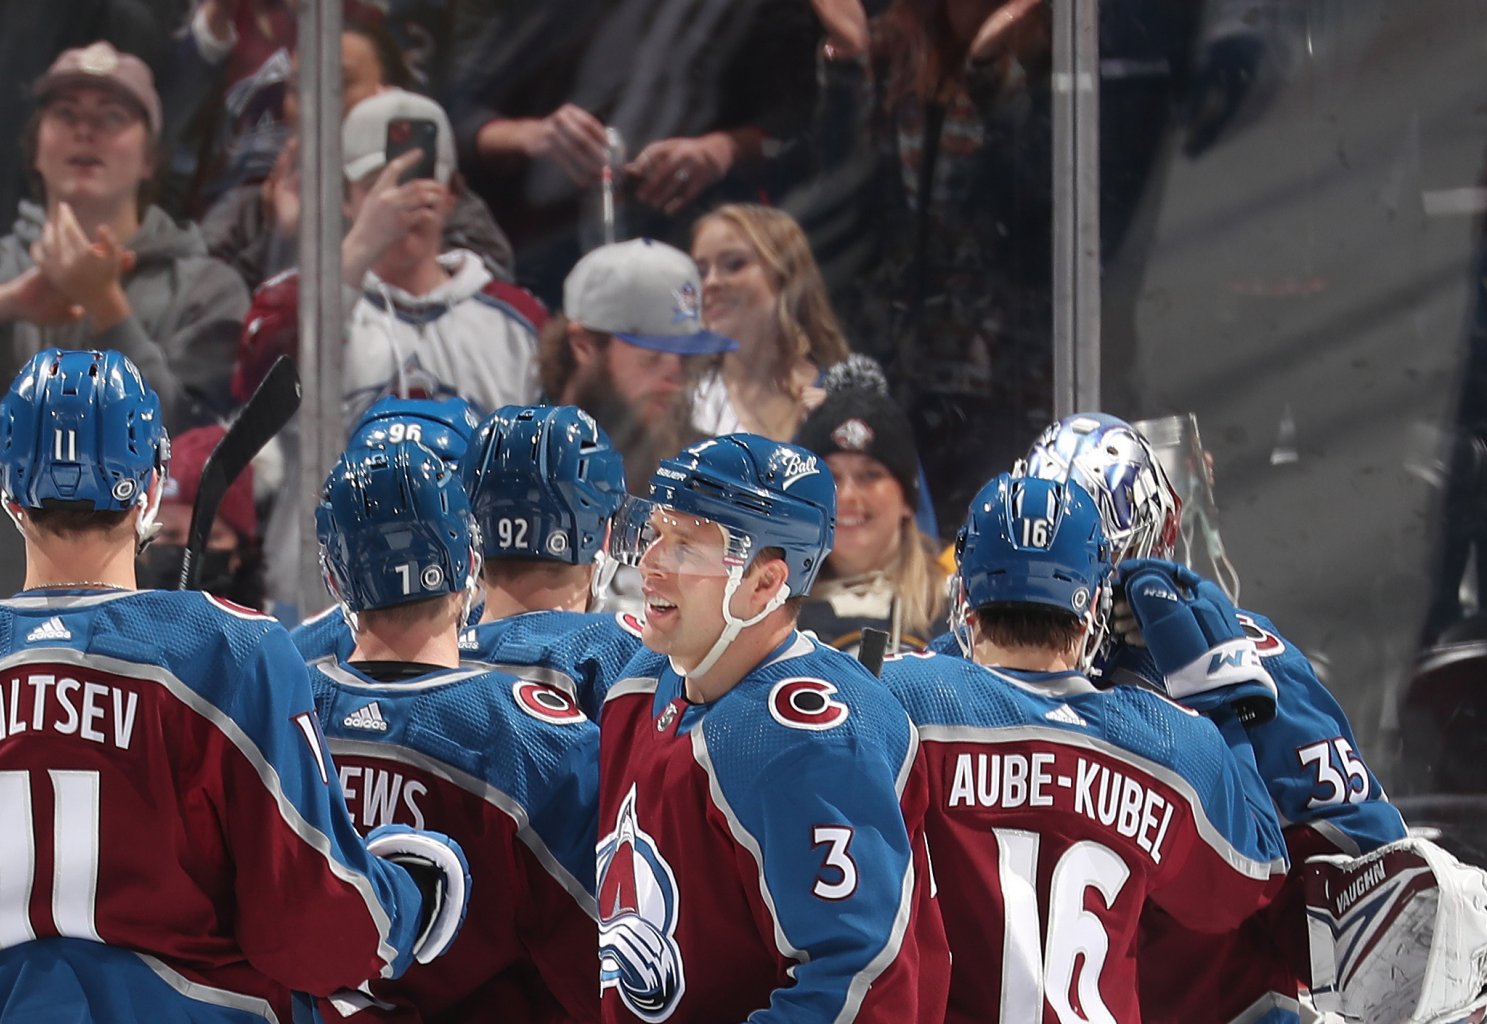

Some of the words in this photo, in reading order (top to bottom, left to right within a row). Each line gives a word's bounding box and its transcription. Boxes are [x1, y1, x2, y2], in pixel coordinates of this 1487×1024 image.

[55, 429, 75, 461] 11
[498, 518, 528, 548] 92
[1022, 518, 1047, 548] 16
[395, 565, 411, 595] 7
[343, 716, 388, 731] adidas
[1298, 737, 1370, 809] 35
[948, 752, 1175, 866] AUBE-KUBEL
[813, 824, 859, 901] 3
[1335, 859, 1387, 915] VAUGHN
